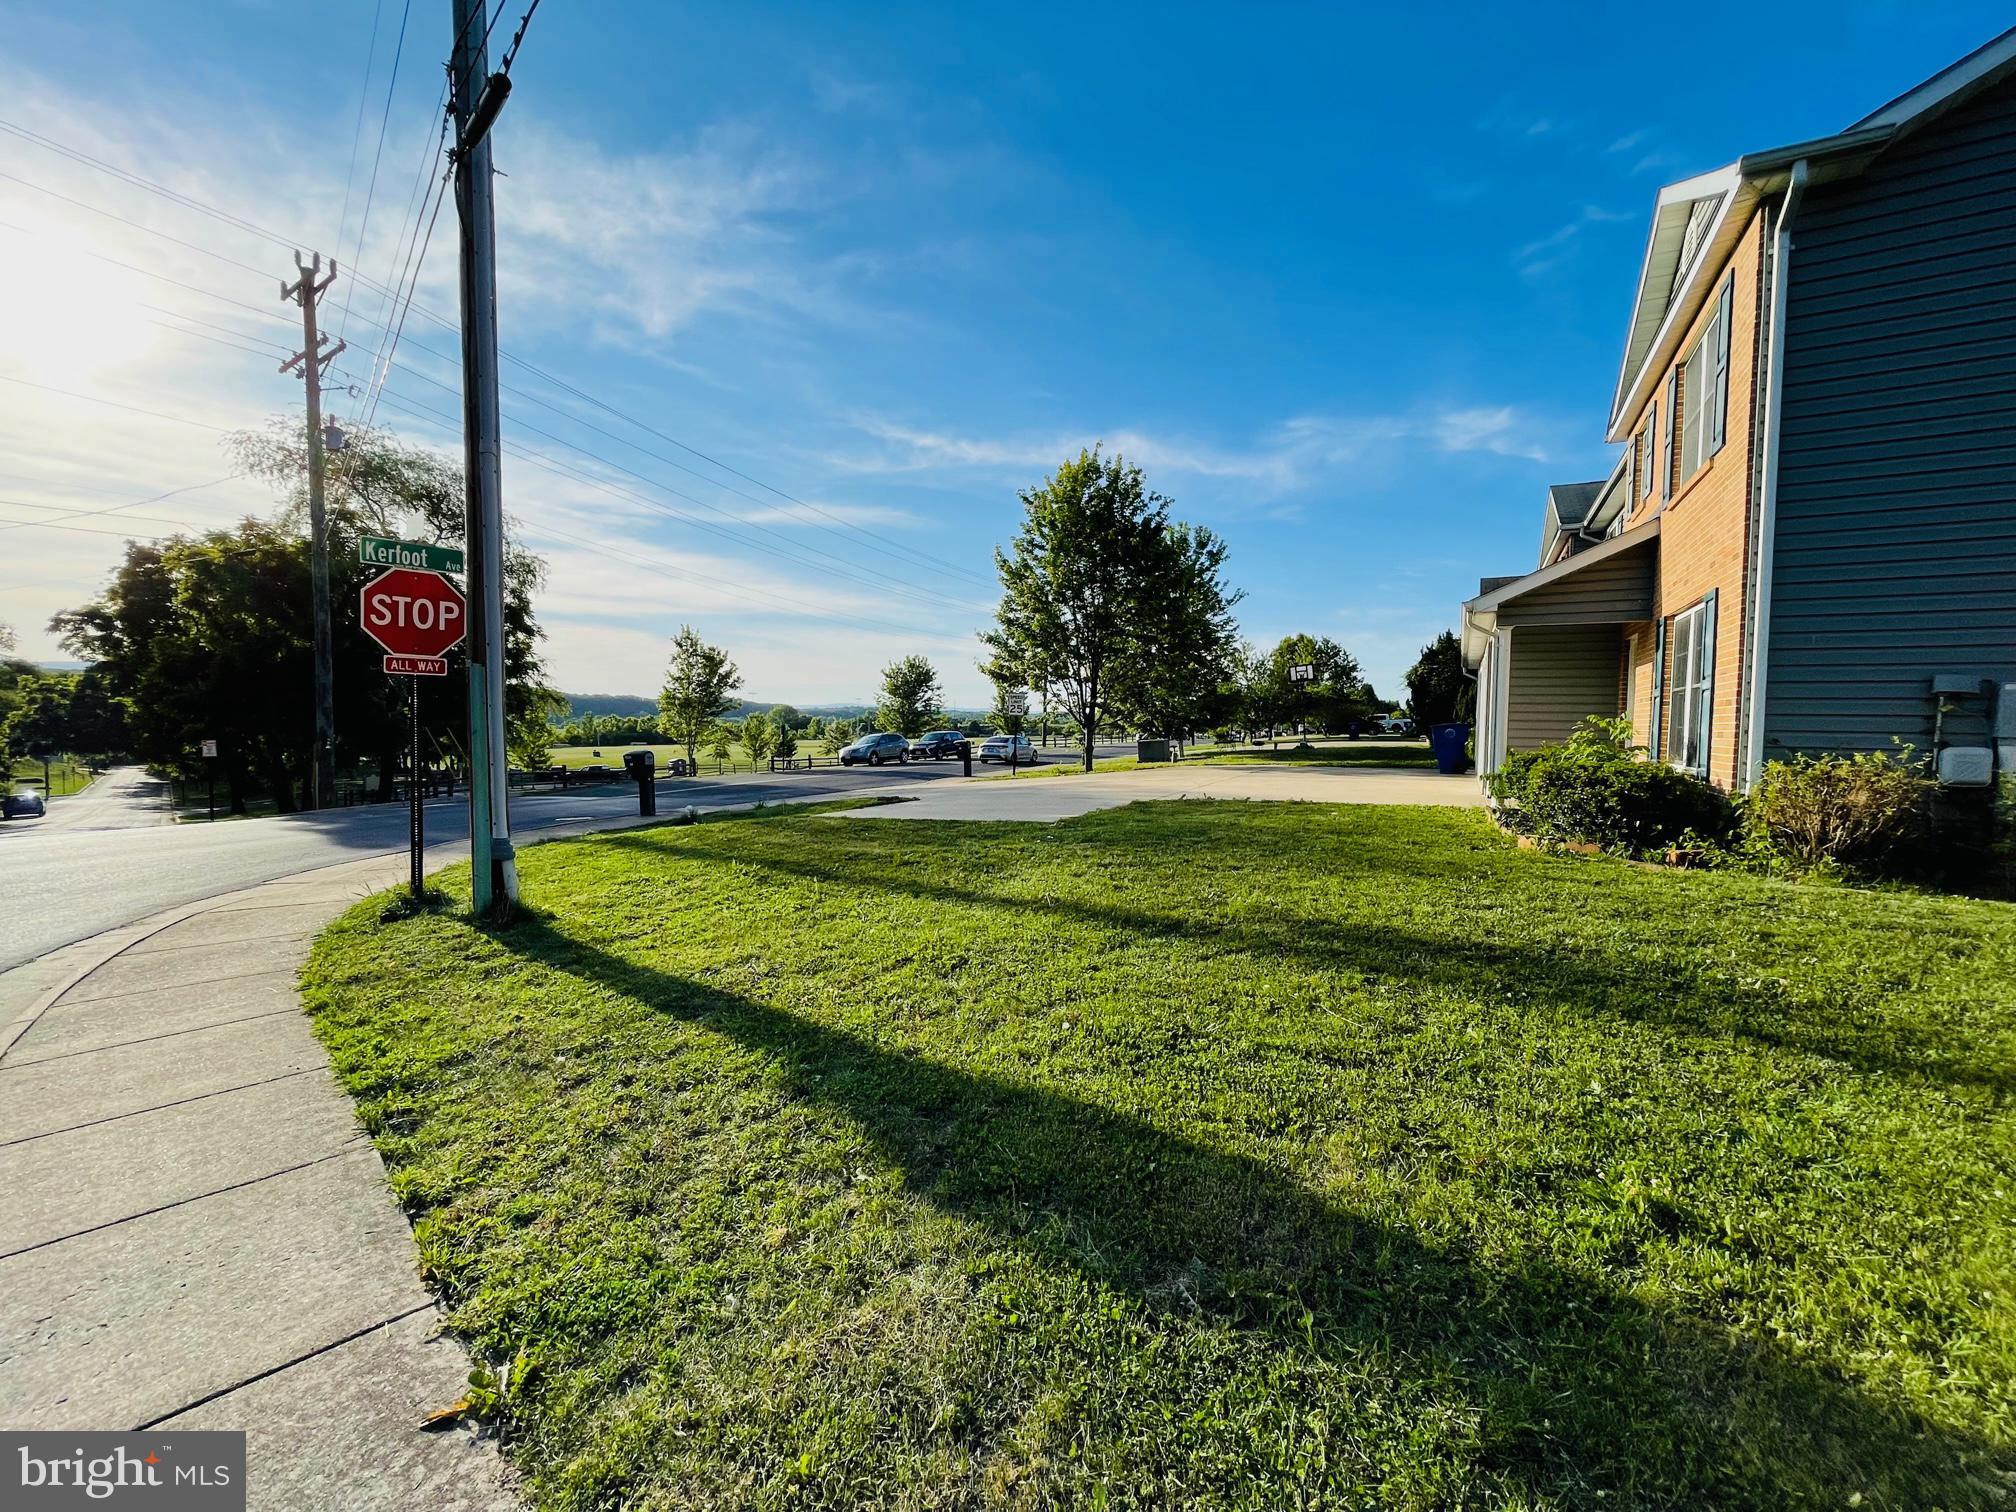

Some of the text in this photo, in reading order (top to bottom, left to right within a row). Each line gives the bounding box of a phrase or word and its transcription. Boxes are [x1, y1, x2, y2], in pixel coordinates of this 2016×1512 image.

[365, 541, 461, 572] Kerfoot Ave
[370, 594, 460, 631] STOP
[391, 660, 441, 672] ALL WAY
[1010, 705, 1023, 713] 25
